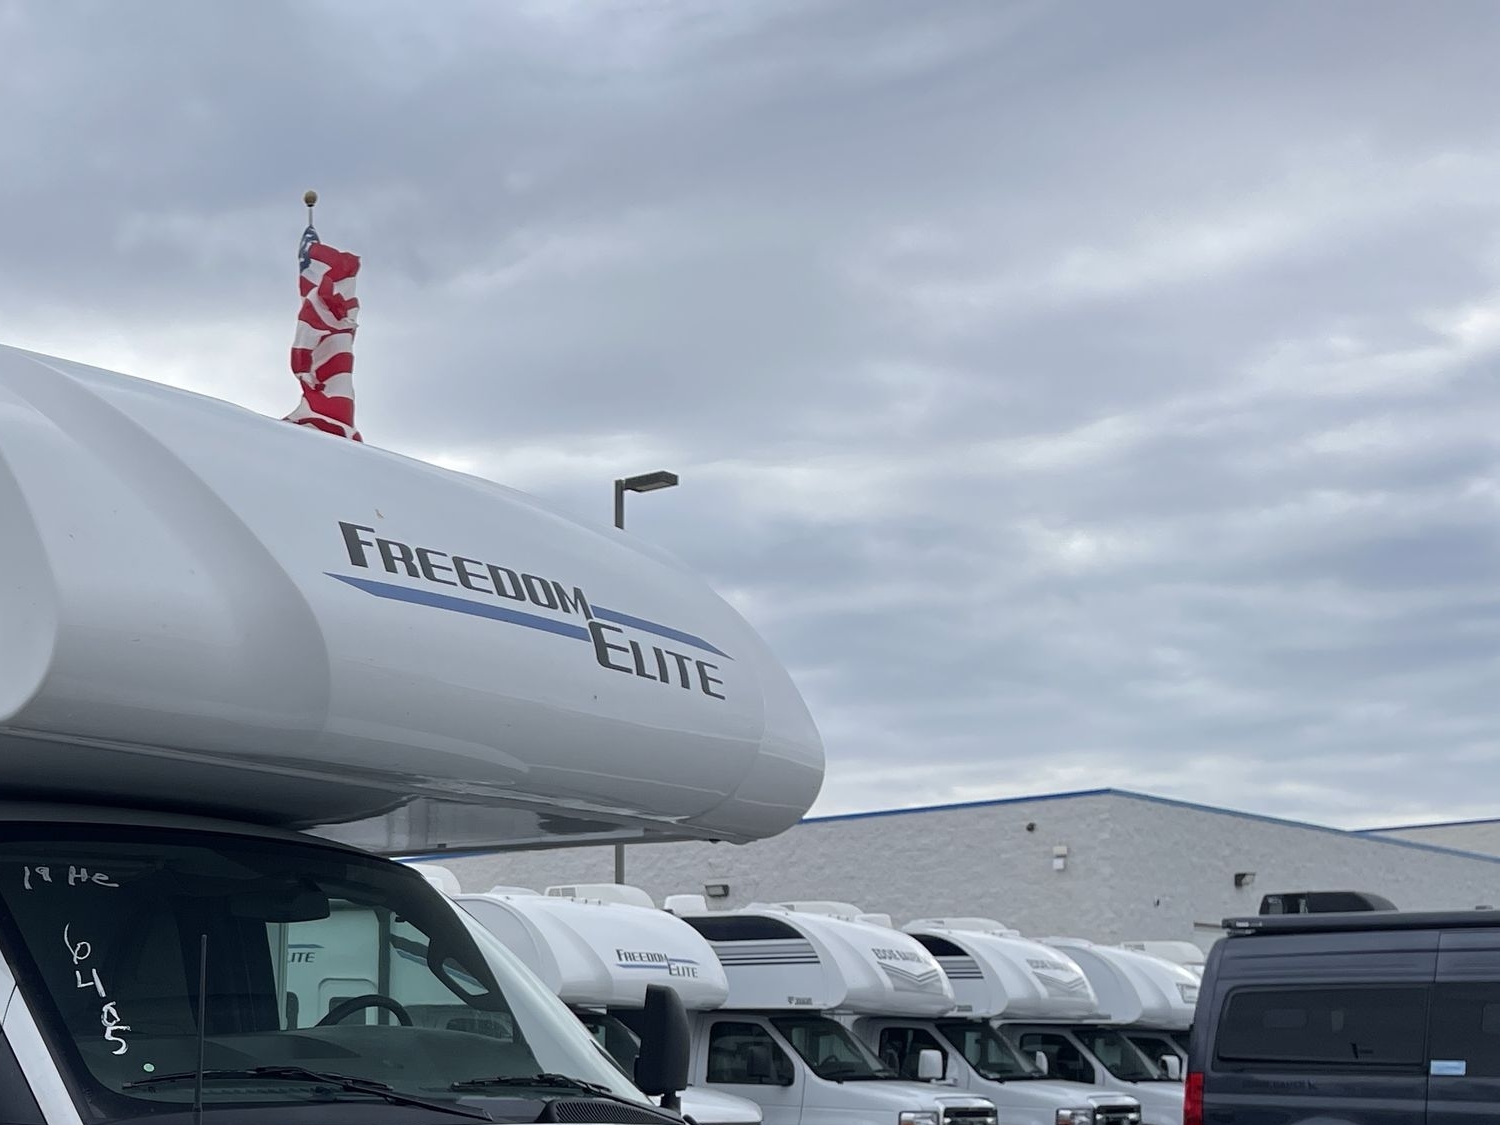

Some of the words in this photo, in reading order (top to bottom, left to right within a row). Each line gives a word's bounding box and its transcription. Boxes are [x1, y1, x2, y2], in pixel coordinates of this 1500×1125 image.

[338, 521, 593, 620] FREEDOM
[589, 621, 725, 700] ELITE
[615, 948, 668, 963] FREEDOM
[667, 960, 699, 979] ELITE
